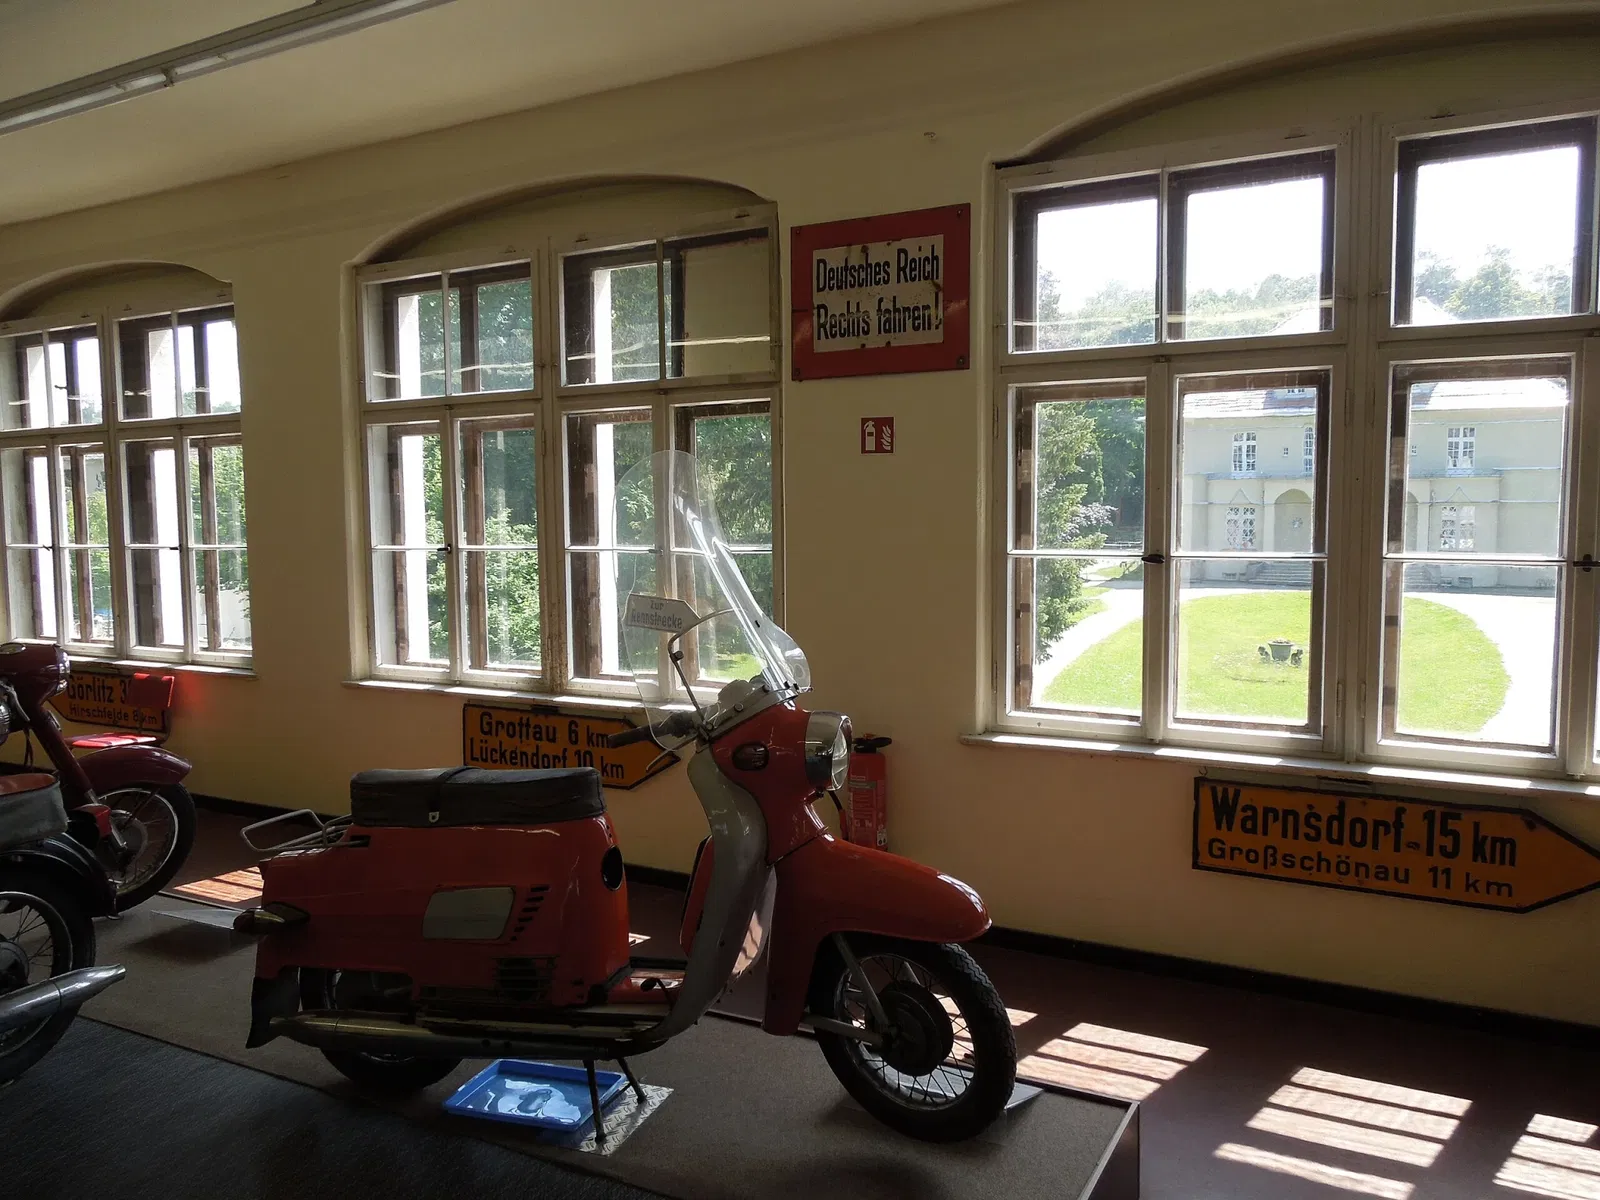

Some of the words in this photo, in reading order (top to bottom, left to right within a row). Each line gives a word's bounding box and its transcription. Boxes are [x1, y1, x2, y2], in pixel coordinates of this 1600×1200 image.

[816, 252, 890, 293] Deutsches
[896, 244, 940, 284] Reich
[817, 301, 871, 341] Rechts
[876, 291, 942, 335] fahren!
[67, 675, 114, 704] Görlitz
[69, 702, 129, 722] Hirschfelde
[480, 711, 557, 743] Grottau
[568, 720, 579, 746] 6
[586, 725, 609, 748] km
[470, 737, 568, 769] Lückendorf
[574, 750, 594, 768] 10
[600, 756, 625, 779] km
[1210, 785, 1407, 854] Warnsdorf
[1423, 807, 1463, 860] 15
[1472, 821, 1517, 867] km
[1207, 837, 1410, 885] Großschönau
[1427, 865, 1452, 890] 11
[1465, 871, 1514, 899] km
